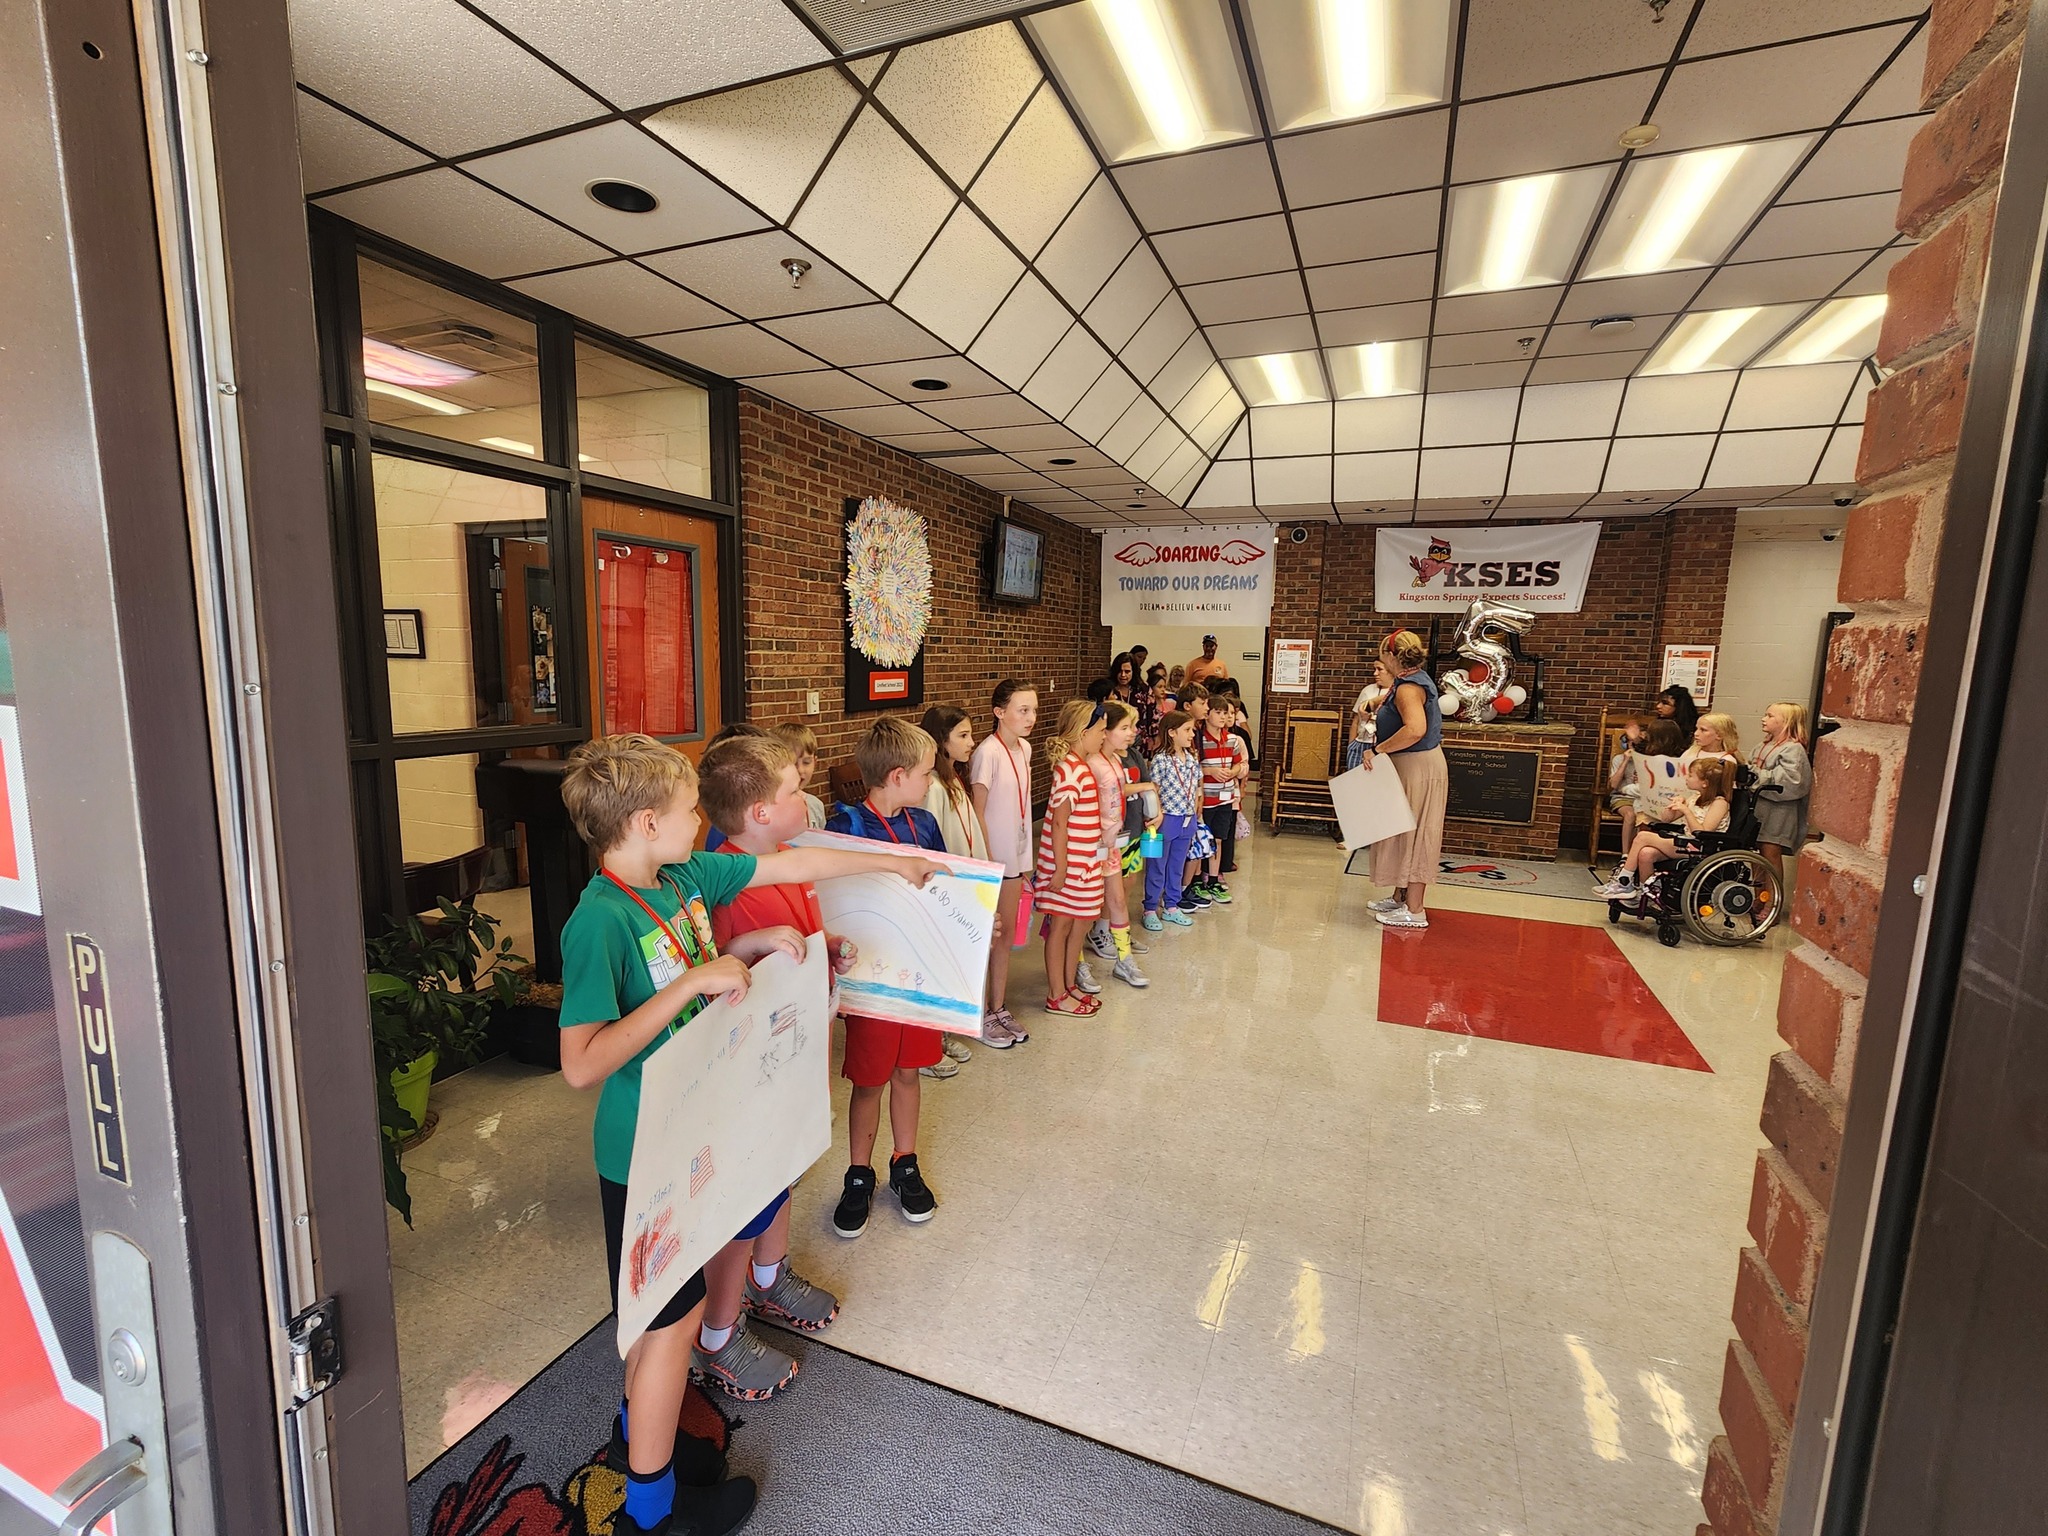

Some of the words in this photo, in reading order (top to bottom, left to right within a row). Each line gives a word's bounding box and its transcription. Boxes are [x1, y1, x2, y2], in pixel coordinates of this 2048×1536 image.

[1155, 545, 1221, 563] SOARING
[1119, 576, 1169, 591] TOWARD
[1172, 575, 1200, 591] OUR
[1203, 574, 1259, 591] DREAMS
[1443, 561, 1561, 587] KSES
[1399, 593, 1440, 602] Kingston
[1443, 592, 1479, 603] Springs
[1481, 592, 1521, 601] Expects
[1522, 592, 1567, 601] Success!
[76, 944, 119, 1172] PULL
